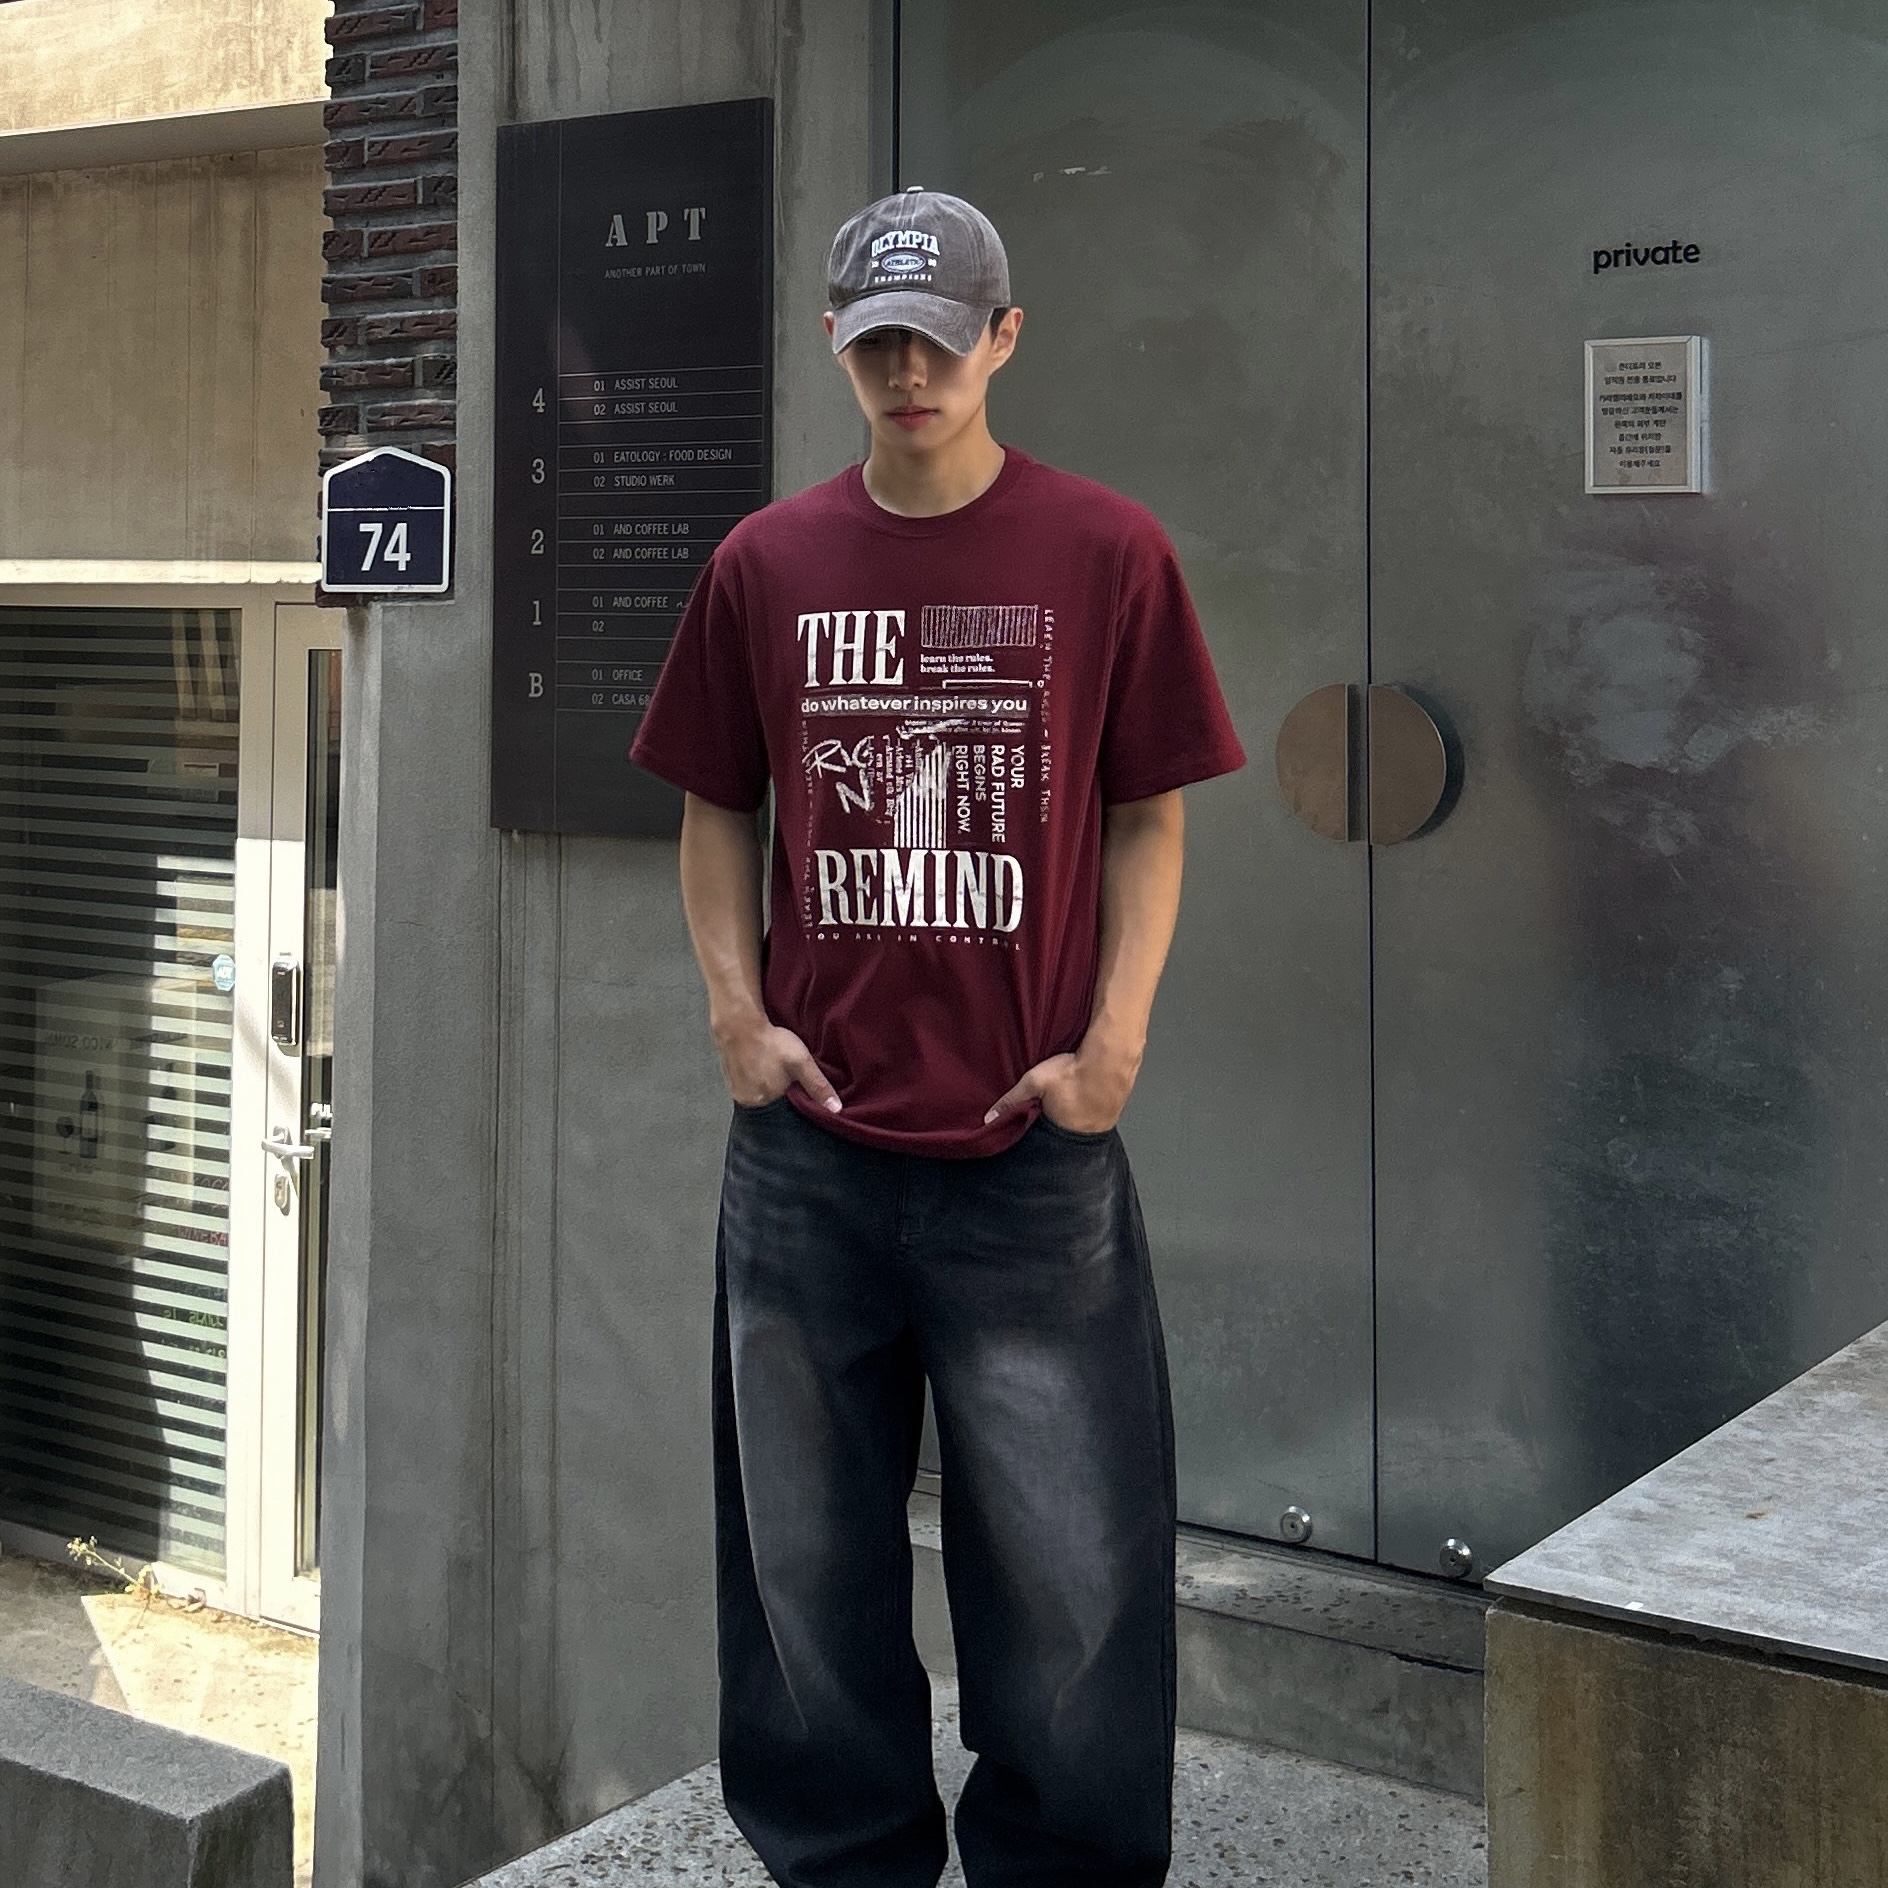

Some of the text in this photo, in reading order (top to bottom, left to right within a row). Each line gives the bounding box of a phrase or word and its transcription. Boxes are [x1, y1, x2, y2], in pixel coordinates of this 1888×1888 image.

[871, 230, 940, 258] OLYMPIA
[1593, 240, 1700, 274] private
[604, 263, 706, 279] ANOTHER PART OF TOWN
[593, 377, 678, 391] 01 ASSIST SEOUL
[532, 387, 546, 413] 4
[593, 401, 678, 416] 02 ASSIST SEOUL
[593, 452, 605, 464] 01
[614, 450, 661, 463] EATOLOGY
[669, 450, 694, 461] FOOD
[697, 449, 732, 461] DESIGN
[531, 457, 545, 484] 3
[593, 474, 675, 488] 02 STUDIO WERK
[593, 523, 690, 535] 01 AND COFFEE LAB
[359, 522, 411, 571] 74
[530, 529, 545, 554] 2
[593, 548, 689, 560] 02 AND COFFEE LAB
[532, 600, 542, 626] 1
[592, 596, 604, 608] 01
[612, 596, 632, 608] AND
[634, 596, 668, 608] COFFEE
[592, 620, 605, 632] 02
[797, 609, 905, 688] THE
[920, 653, 947, 663] learn
[948, 653, 964, 663] the
[592, 669, 643, 682] 01 OFFICE
[920, 663, 949, 673] break
[950, 663, 966, 673] the
[528, 672, 544, 698] B
[591, 693, 604, 705] 02
[612, 694, 637, 706] CASA
[801, 695, 1027, 717] do whatever inspires you
[955, 745, 970, 790] RIGHT
[973, 744, 987, 802] BEGINS
[1010, 744, 1025, 789] YOUR
[990, 745, 1006, 843] RAD FUTURE
[814, 848, 1024, 933] REMIND
[935, 935, 1020, 951] CONTRL
